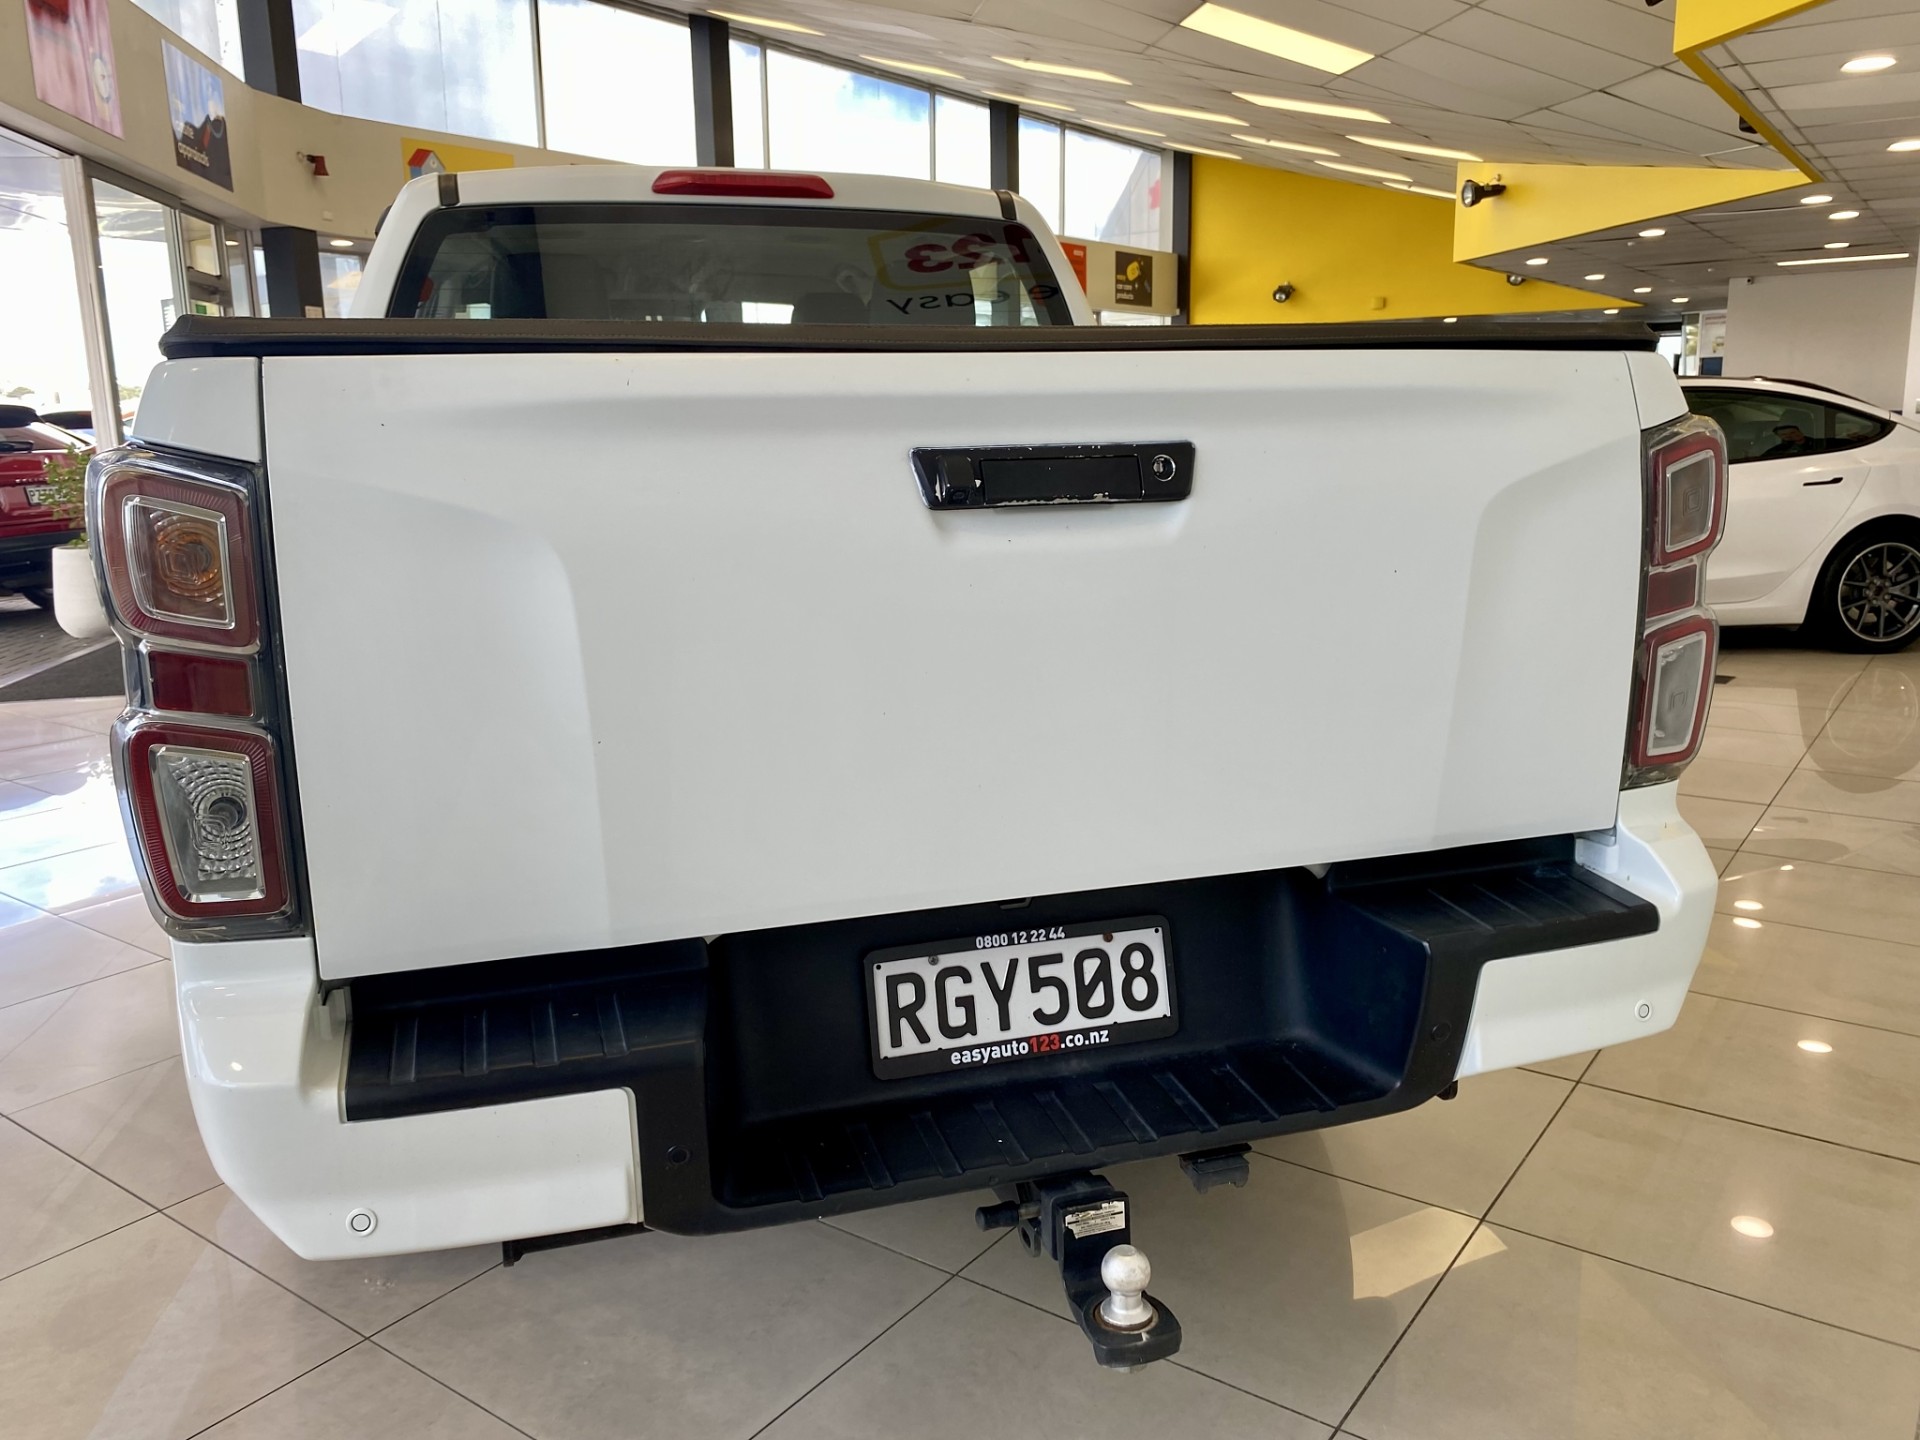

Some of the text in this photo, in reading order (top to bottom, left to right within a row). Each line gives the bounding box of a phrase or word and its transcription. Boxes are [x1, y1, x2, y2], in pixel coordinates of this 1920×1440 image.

[975, 926, 1066, 949] 0800 12 22 44
[885, 941, 1159, 1048] RGY508
[950, 1029, 1109, 1065] easyauto123.co.nz
